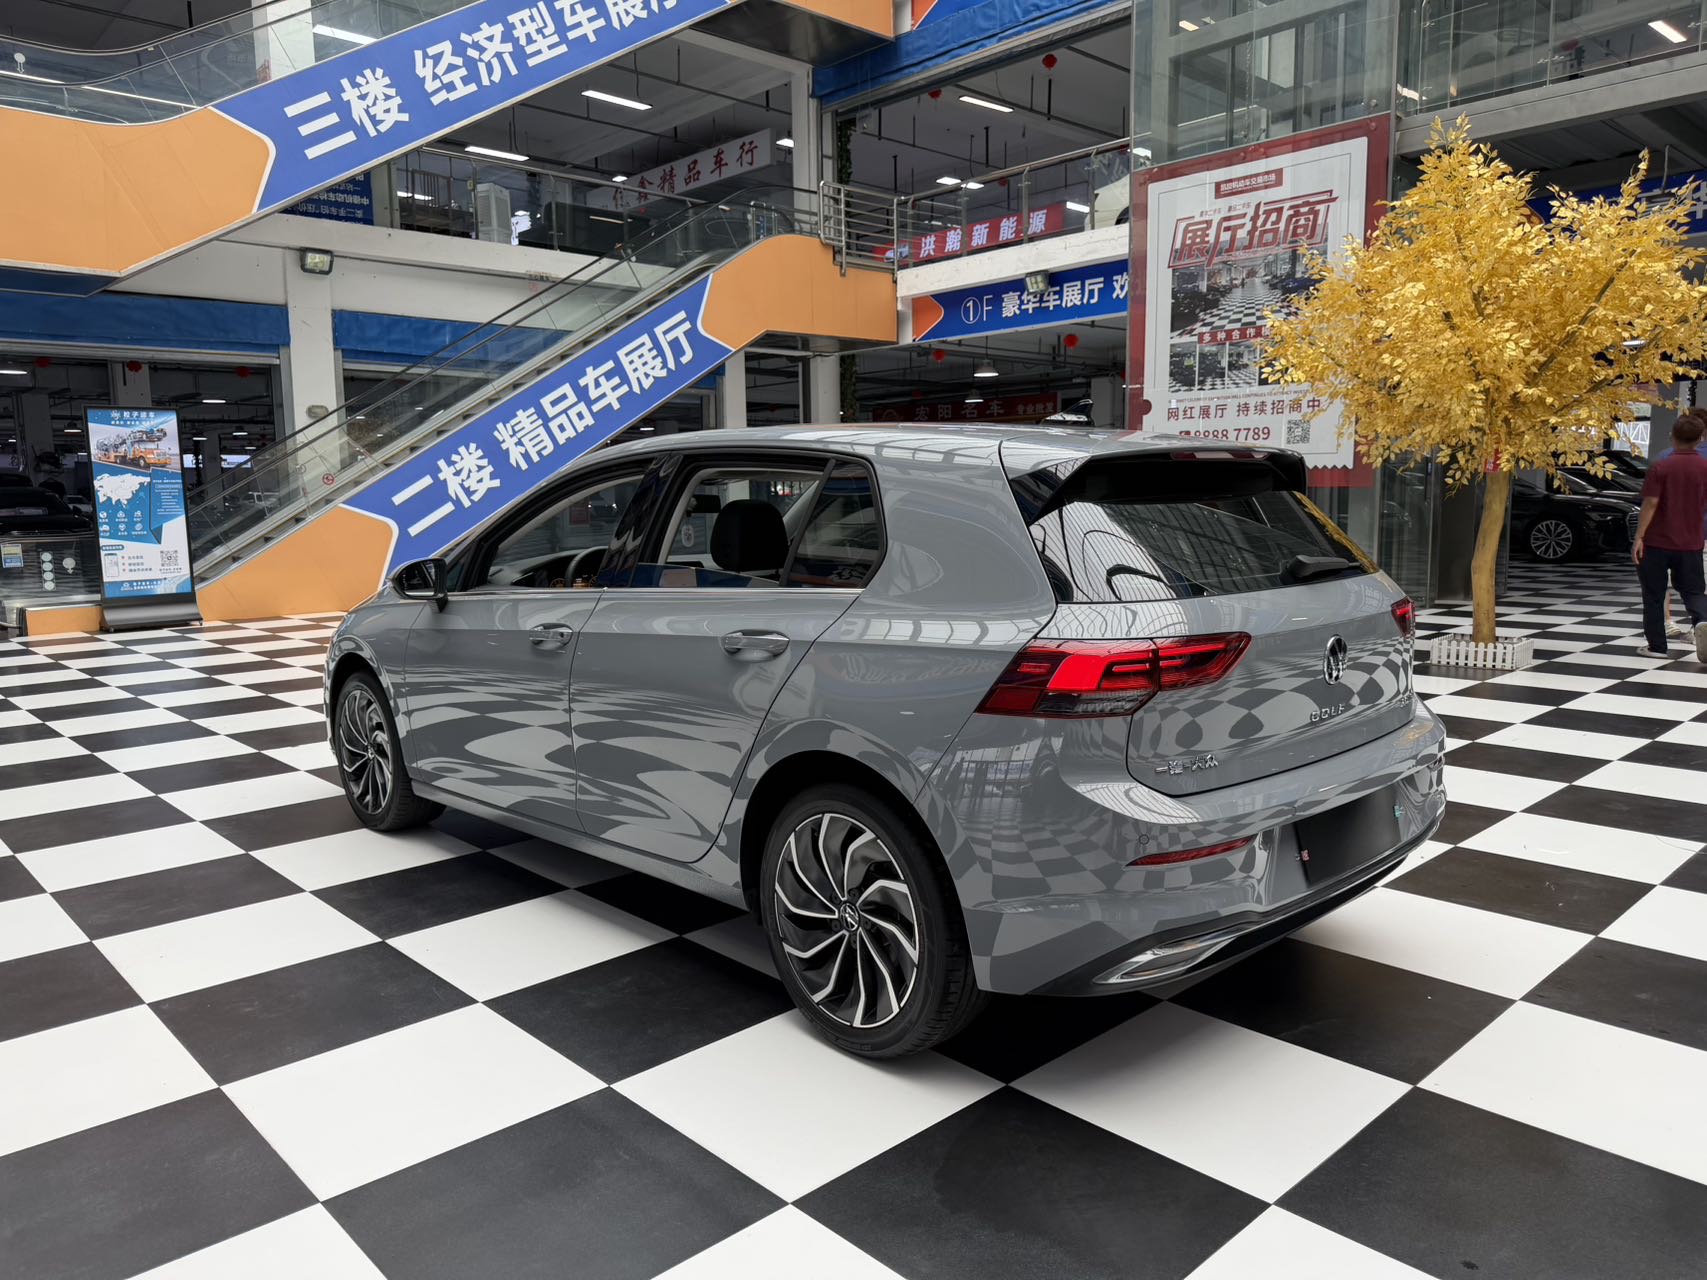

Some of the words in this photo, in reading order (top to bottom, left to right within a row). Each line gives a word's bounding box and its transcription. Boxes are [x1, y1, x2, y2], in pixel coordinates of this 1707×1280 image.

[284, 67, 410, 160] 三楼
[414, 0, 677, 106] 经济型车展
[919, 209, 1048, 258] 洪瀚新能源
[1176, 196, 1338, 268] 展厅招商
[1001, 276, 1105, 318] 豪华车展厅
[391, 443, 500, 537] 二楼
[493, 310, 698, 471] 精品车展厅
[1167, 403, 1228, 421] 网红展厅
[1236, 396, 1322, 417] 持续招商中
[1233, 426, 1271, 441] 7789
[1310, 703, 1345, 722] GOLF
